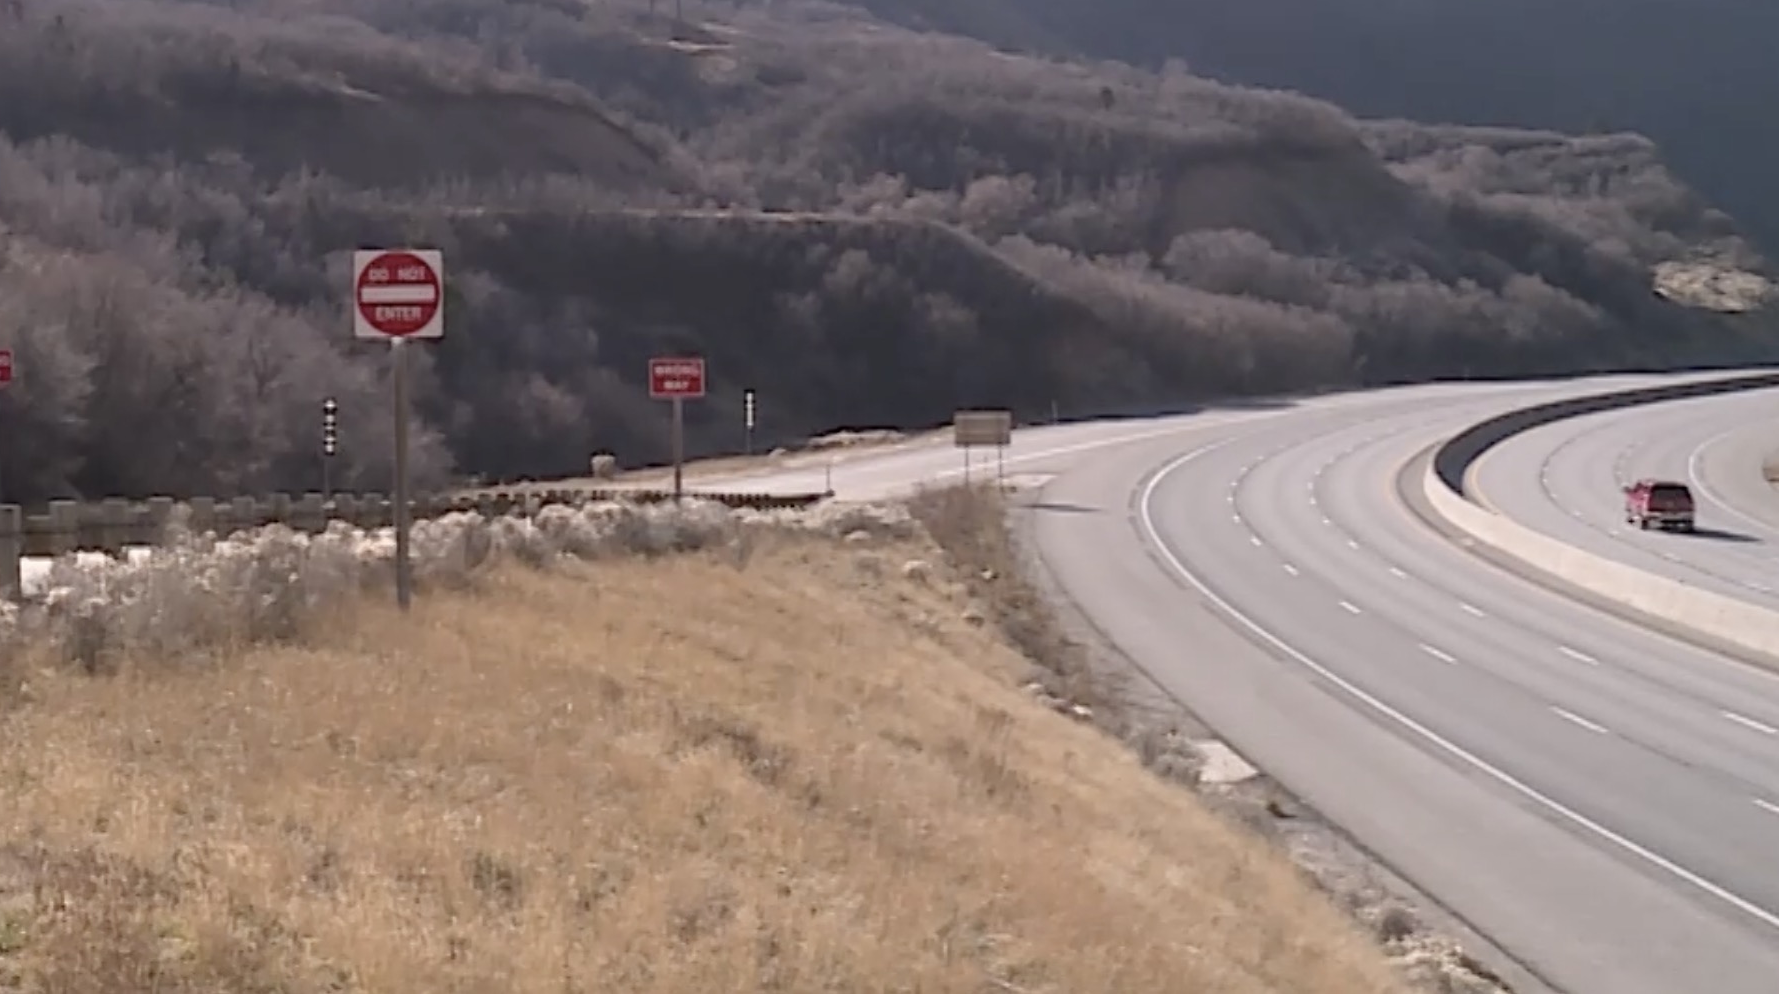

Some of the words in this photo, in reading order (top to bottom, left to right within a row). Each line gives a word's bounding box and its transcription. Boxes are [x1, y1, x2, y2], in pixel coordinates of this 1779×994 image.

[367, 267, 390, 281] DO
[397, 265, 426, 281] NOT
[374, 306, 422, 322] ENTER
